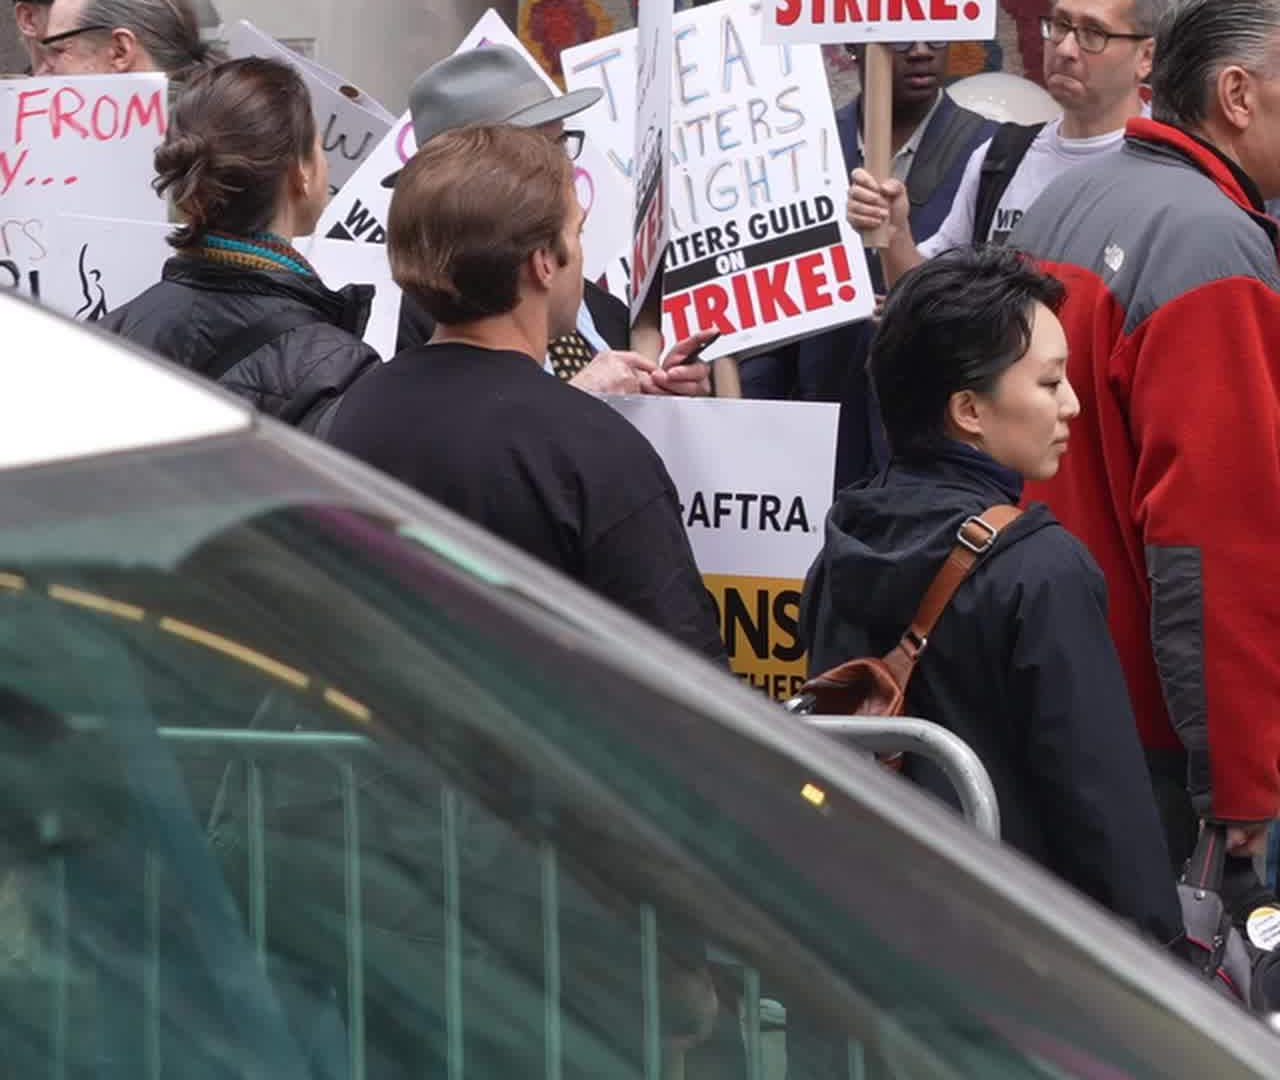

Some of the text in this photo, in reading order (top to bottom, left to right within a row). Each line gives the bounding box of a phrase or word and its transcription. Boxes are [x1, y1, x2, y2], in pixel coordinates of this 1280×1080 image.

[15, 86, 165, 144] FROM
[671, 127, 831, 231] IGHT!
[748, 195, 835, 240] GUILD
[715, 253, 746, 275] ON
[661, 244, 856, 348] TRIKE!
